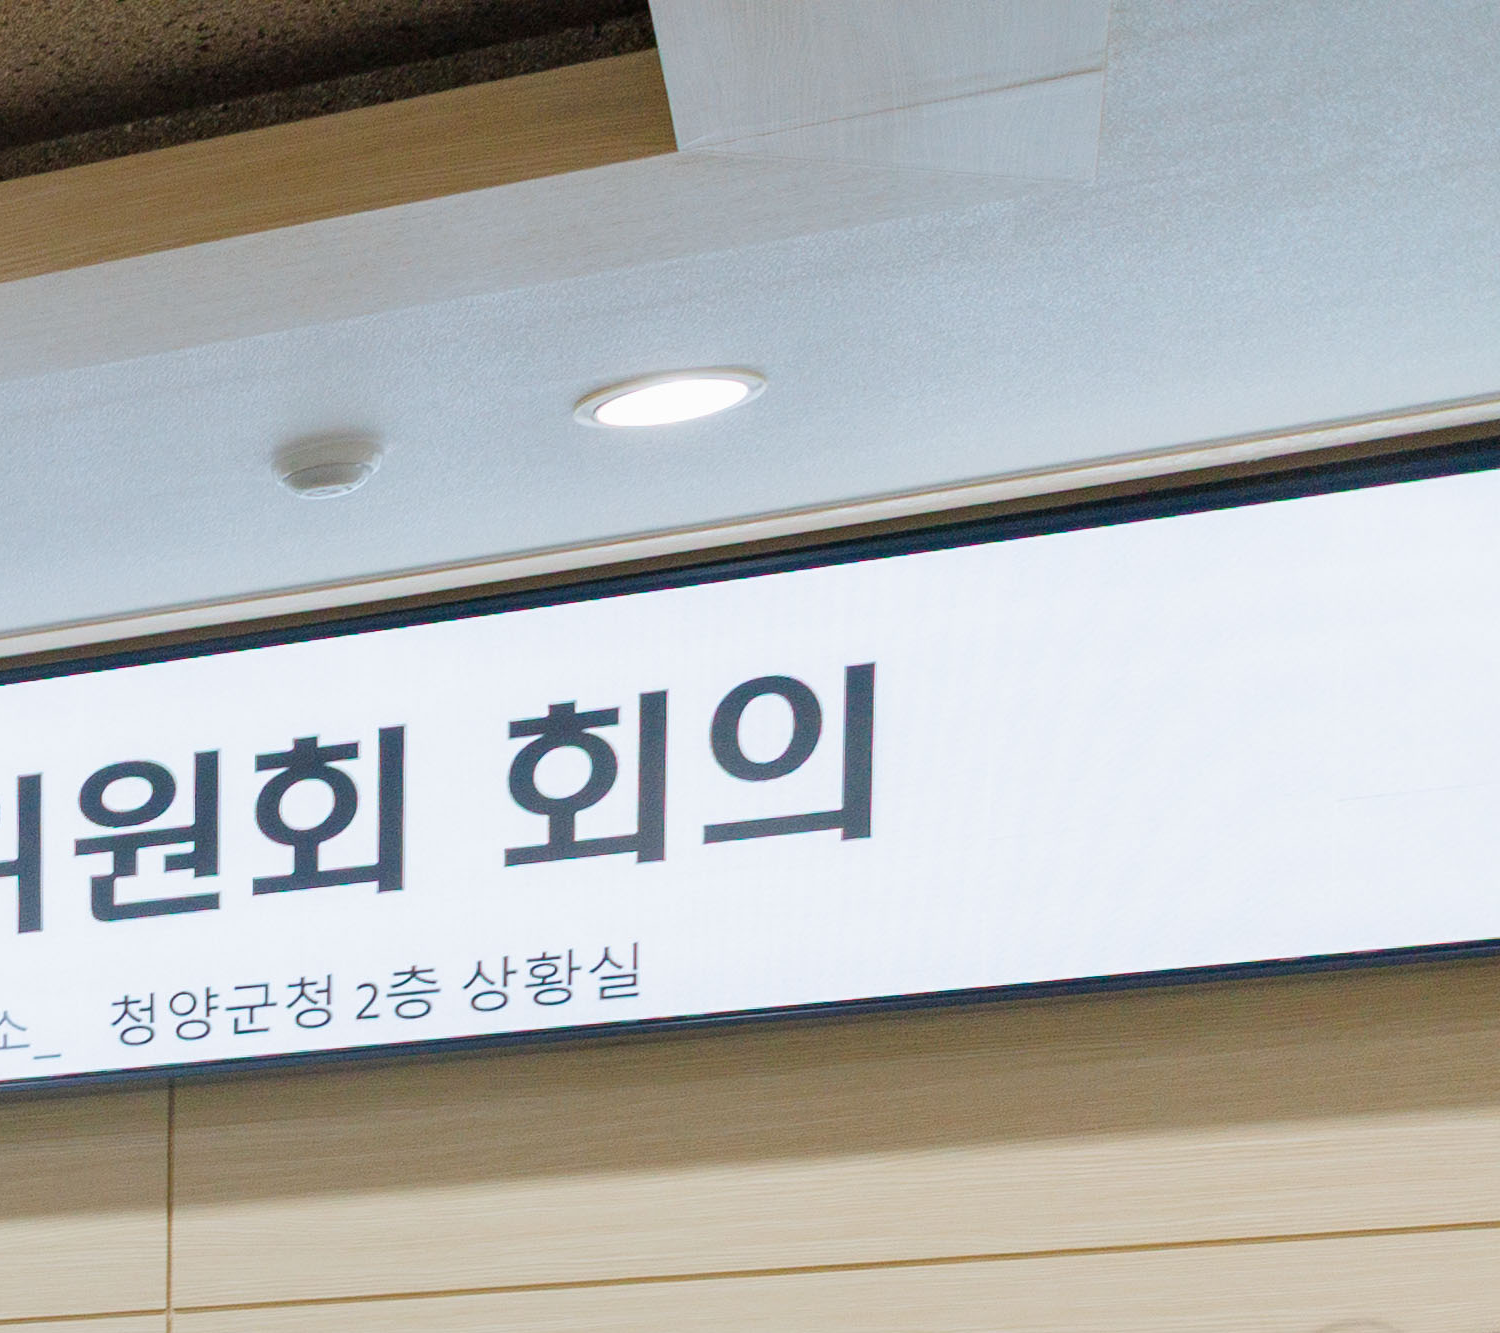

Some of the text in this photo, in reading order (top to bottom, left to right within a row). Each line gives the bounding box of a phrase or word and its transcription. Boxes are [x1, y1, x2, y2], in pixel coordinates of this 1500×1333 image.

[503, 662, 878, 868] 회의
[111, 974, 334, 1046] 청양군청
[356, 965, 441, 1020] 2층
[462, 942, 641, 1013] 상황실
